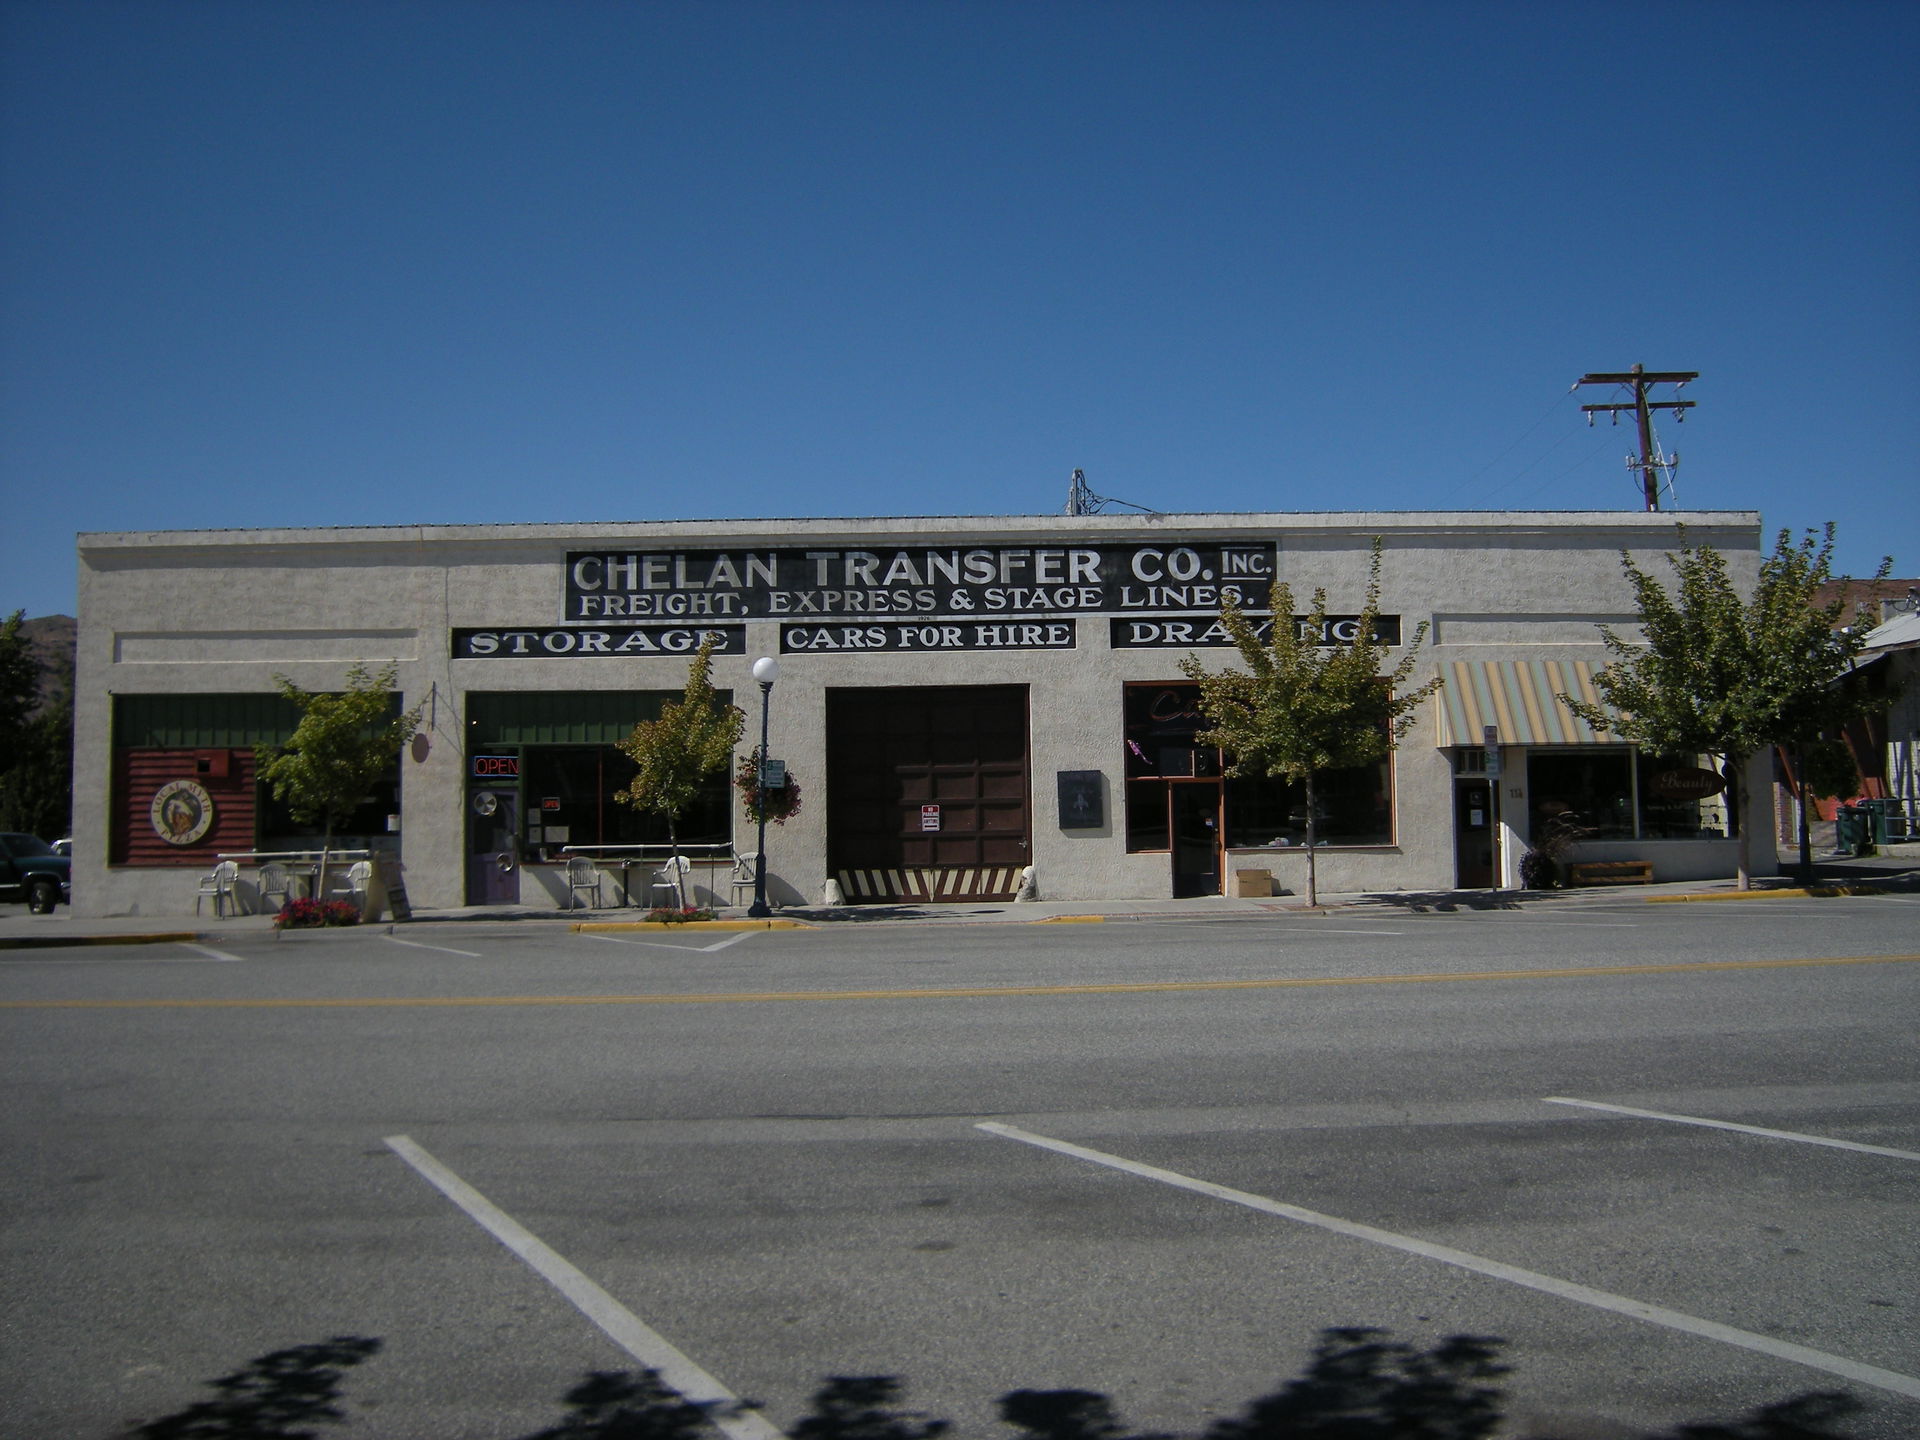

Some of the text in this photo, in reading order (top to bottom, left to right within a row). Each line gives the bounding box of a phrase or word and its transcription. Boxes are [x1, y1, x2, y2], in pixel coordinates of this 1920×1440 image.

[573, 548, 1272, 590] CHELAN TRANSFER CO. INC.
[579, 585, 1254, 616] FREIGHT, EXPRESS & STAGE LINES.
[470, 629, 728, 654] STORAGE
[786, 623, 1070, 649] CARS FOR HIRE
[1130, 620, 1378, 643] DRAYNG.
[476, 758, 519, 774] OPEN
[153, 782, 211, 814] LOCAL MYTH
[160, 829, 201, 843] PIZZA
